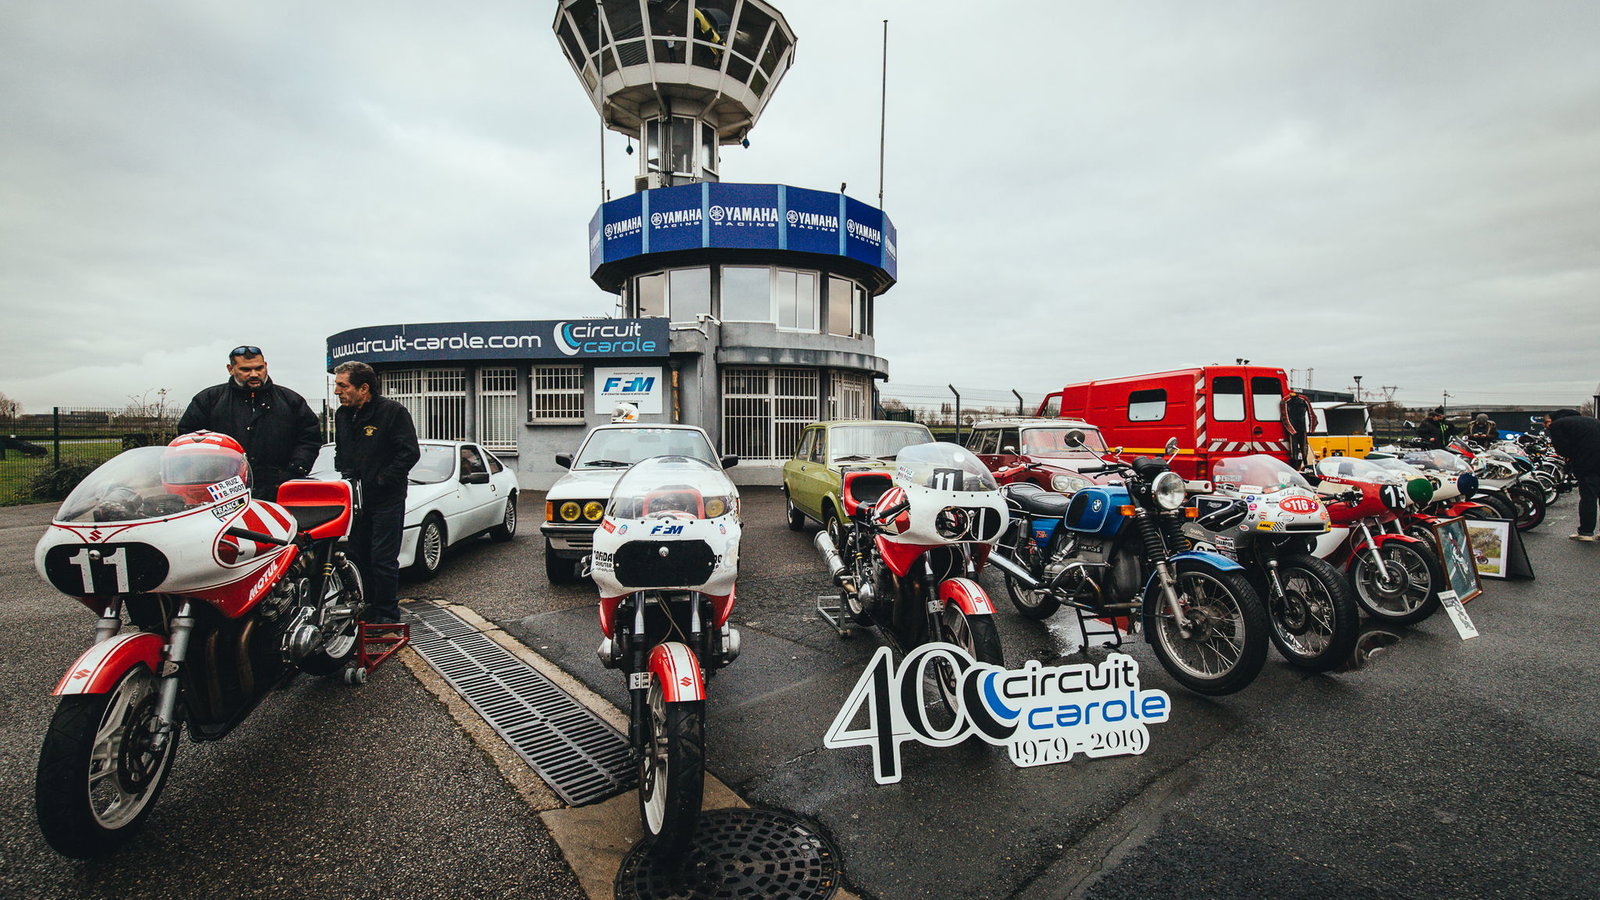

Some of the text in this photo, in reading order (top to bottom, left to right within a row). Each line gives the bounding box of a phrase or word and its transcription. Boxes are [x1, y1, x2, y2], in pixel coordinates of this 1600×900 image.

[662, 208, 702, 223] YAMAHA
[725, 207, 779, 221] YAMAHA
[799, 212, 838, 228] YAMAHA
[612, 216, 642, 234] YAMAHA
[655, 221, 700, 229] RACING
[790, 224, 836, 232] RACING
[855, 221, 881, 243] YAMAHA
[607, 229, 640, 240] RACING
[849, 233, 880, 246] RACING
[573, 321, 642, 338] circuit
[332, 332, 541, 358] www.circuit-carole.com
[583, 337, 655, 353] carole
[225, 478, 239, 487] RUIZ
[229, 484, 245, 494] PIGOT
[935, 472, 955, 491] 11
[1385, 485, 1407, 508] 15
[213, 499, 240, 515] FRANCE
[1290, 499, 1309, 511] 116
[69, 547, 130, 595] 11
[249, 560, 279, 602] MOTUL
[1003, 660, 1135, 698] circuit
[830, 648, 974, 778] 40
[1028, 690, 1167, 730] carole
[1014, 736, 1069, 765] 1979
[1090, 728, 1145, 761] 2019
